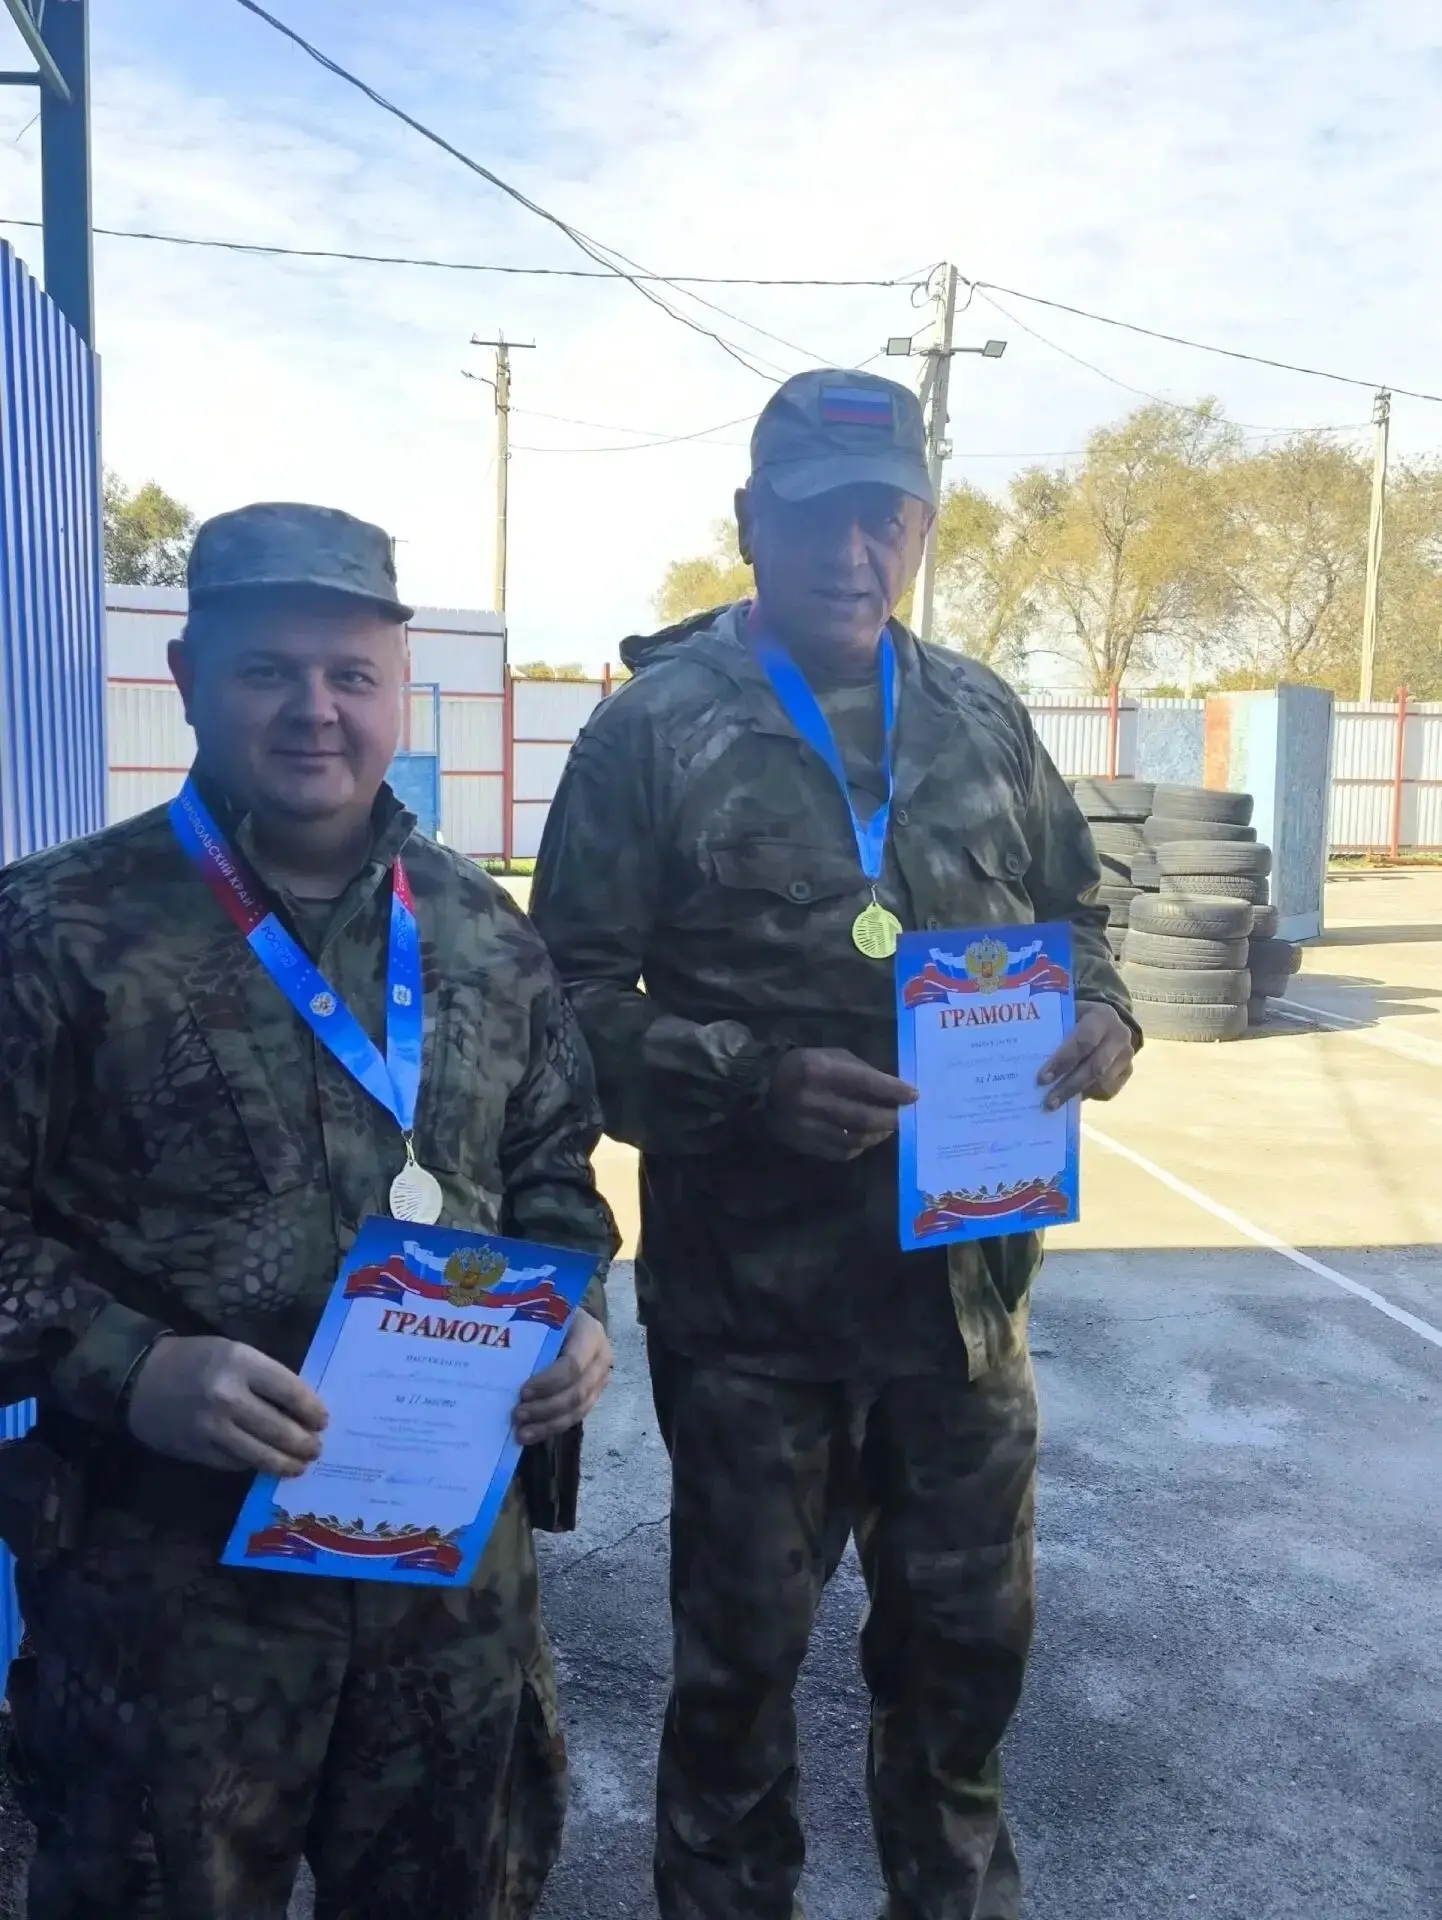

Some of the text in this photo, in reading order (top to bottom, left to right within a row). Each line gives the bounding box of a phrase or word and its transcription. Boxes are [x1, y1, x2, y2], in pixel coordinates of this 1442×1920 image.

[229, 876, 256, 908] КРАЙ
[939, 1001, 1041, 1029] ГРАМОТА
[377, 1308, 512, 1349] ГРАМОТА
